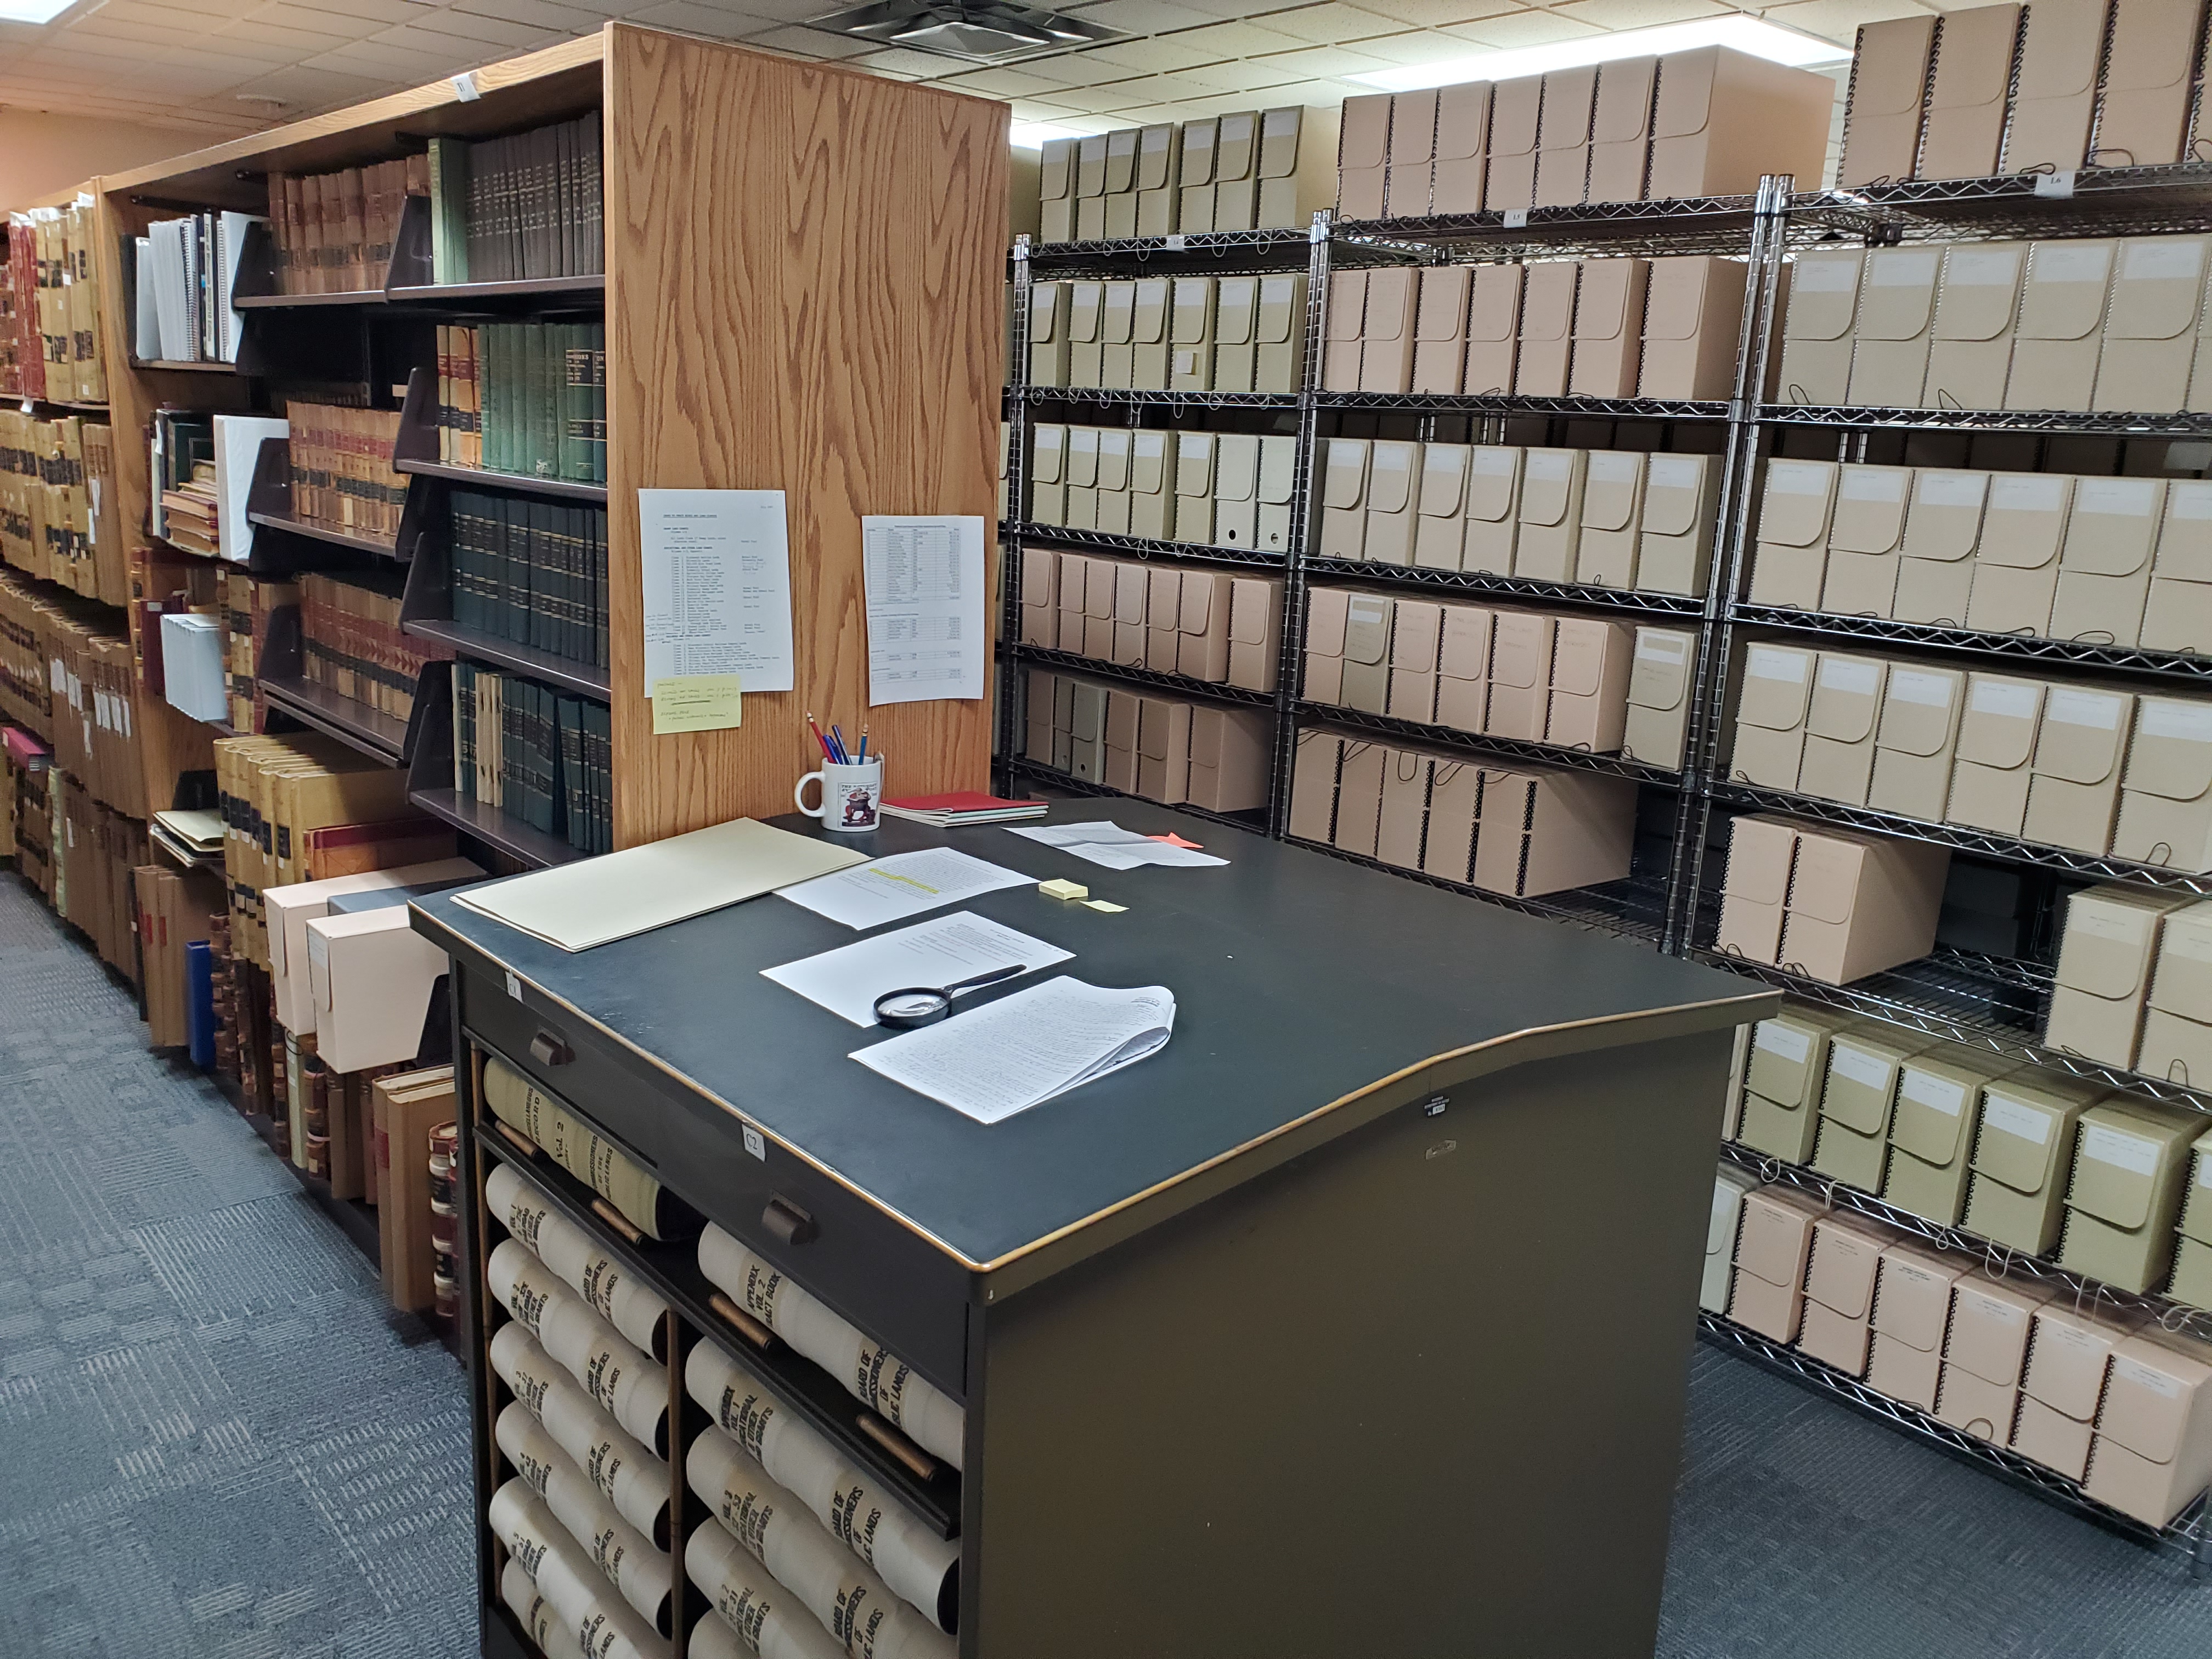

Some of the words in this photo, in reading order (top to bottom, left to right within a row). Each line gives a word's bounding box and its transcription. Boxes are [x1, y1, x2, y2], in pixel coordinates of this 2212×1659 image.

[557, 1121, 563, 1132] 2
[746, 1133, 758, 1150] C2
[605, 1147, 613, 1175] LANDS
[585, 1263, 592, 1277] OF
[758, 1279, 765, 1289] 2
[604, 1273, 617, 1301] LANDS
[747, 1264, 759, 1311] APPENDIX
[765, 1271, 781, 1300] BOOK
[535, 1293, 548, 1323] GRANTS
[590, 1356, 596, 1368] OF
[861, 1349, 871, 1367] OF
[608, 1367, 620, 1396] LANDS
[859, 1367, 867, 1399] BOARD
[880, 1385, 888, 1402] OF
[890, 1364, 909, 1401] LANDS
[721, 1385, 735, 1429] APPENDIX
[747, 1410, 759, 1441] OTHER
[756, 1407, 772, 1444] GRANTS
[590, 1445, 596, 1458] OF
[608, 1458, 620, 1486] LANDS
[834, 1490, 844, 1508] OF
[757, 1505, 772, 1544] GRANTS
[832, 1508, 843, 1538] BOARD
[854, 1527, 861, 1543] OF
[864, 1508, 881, 1544] LANDS
[595, 1532, 600, 1545] OF
[613, 1546, 624, 1573] LANDS
[722, 1584, 729, 1593] 2
[837, 1588, 846, 1606] OF
[583, 1615, 590, 1629] OF
[744, 1604, 755, 1635] OTHER
[753, 1602, 770, 1640] GRANTS
[834, 1606, 843, 1638] BOARD
[865, 1609, 883, 1643] LANDS
[600, 1632, 614, 1658] LANDS
[855, 1626, 862, 1643] OF
